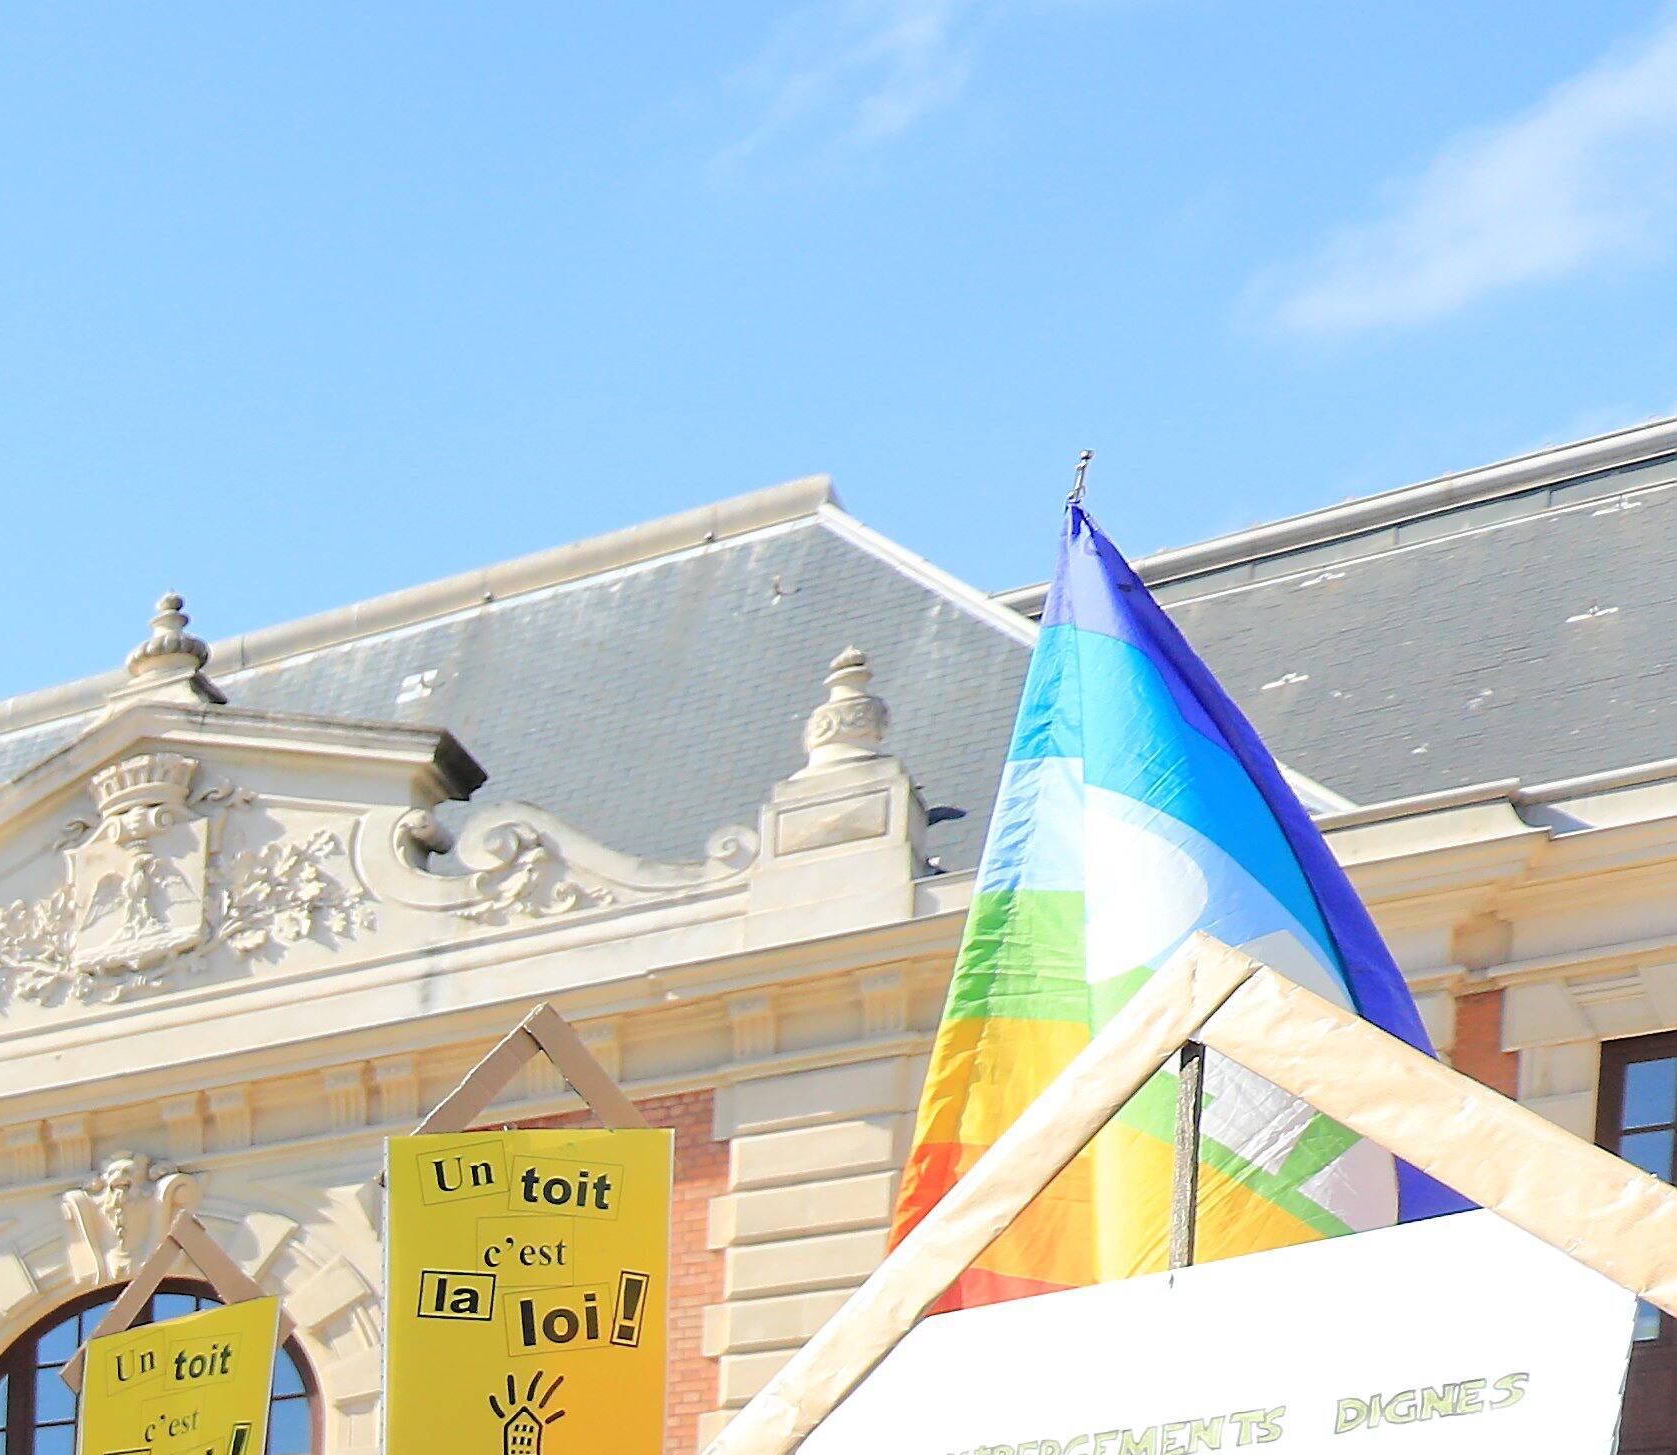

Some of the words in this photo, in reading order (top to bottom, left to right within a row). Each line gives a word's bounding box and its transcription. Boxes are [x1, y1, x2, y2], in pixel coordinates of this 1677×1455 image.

[433, 1157, 493, 1193] Un
[521, 1166, 612, 1210] toit
[483, 1236, 567, 1269] c'est
[435, 1279, 480, 1315] la
[520, 1291, 600, 1348] loi
[115, 1351, 156, 1382] Un
[173, 1343, 231, 1382] toit
[144, 1408, 200, 1444] c'est
[1333, 1373, 1530, 1436] DIGNES
